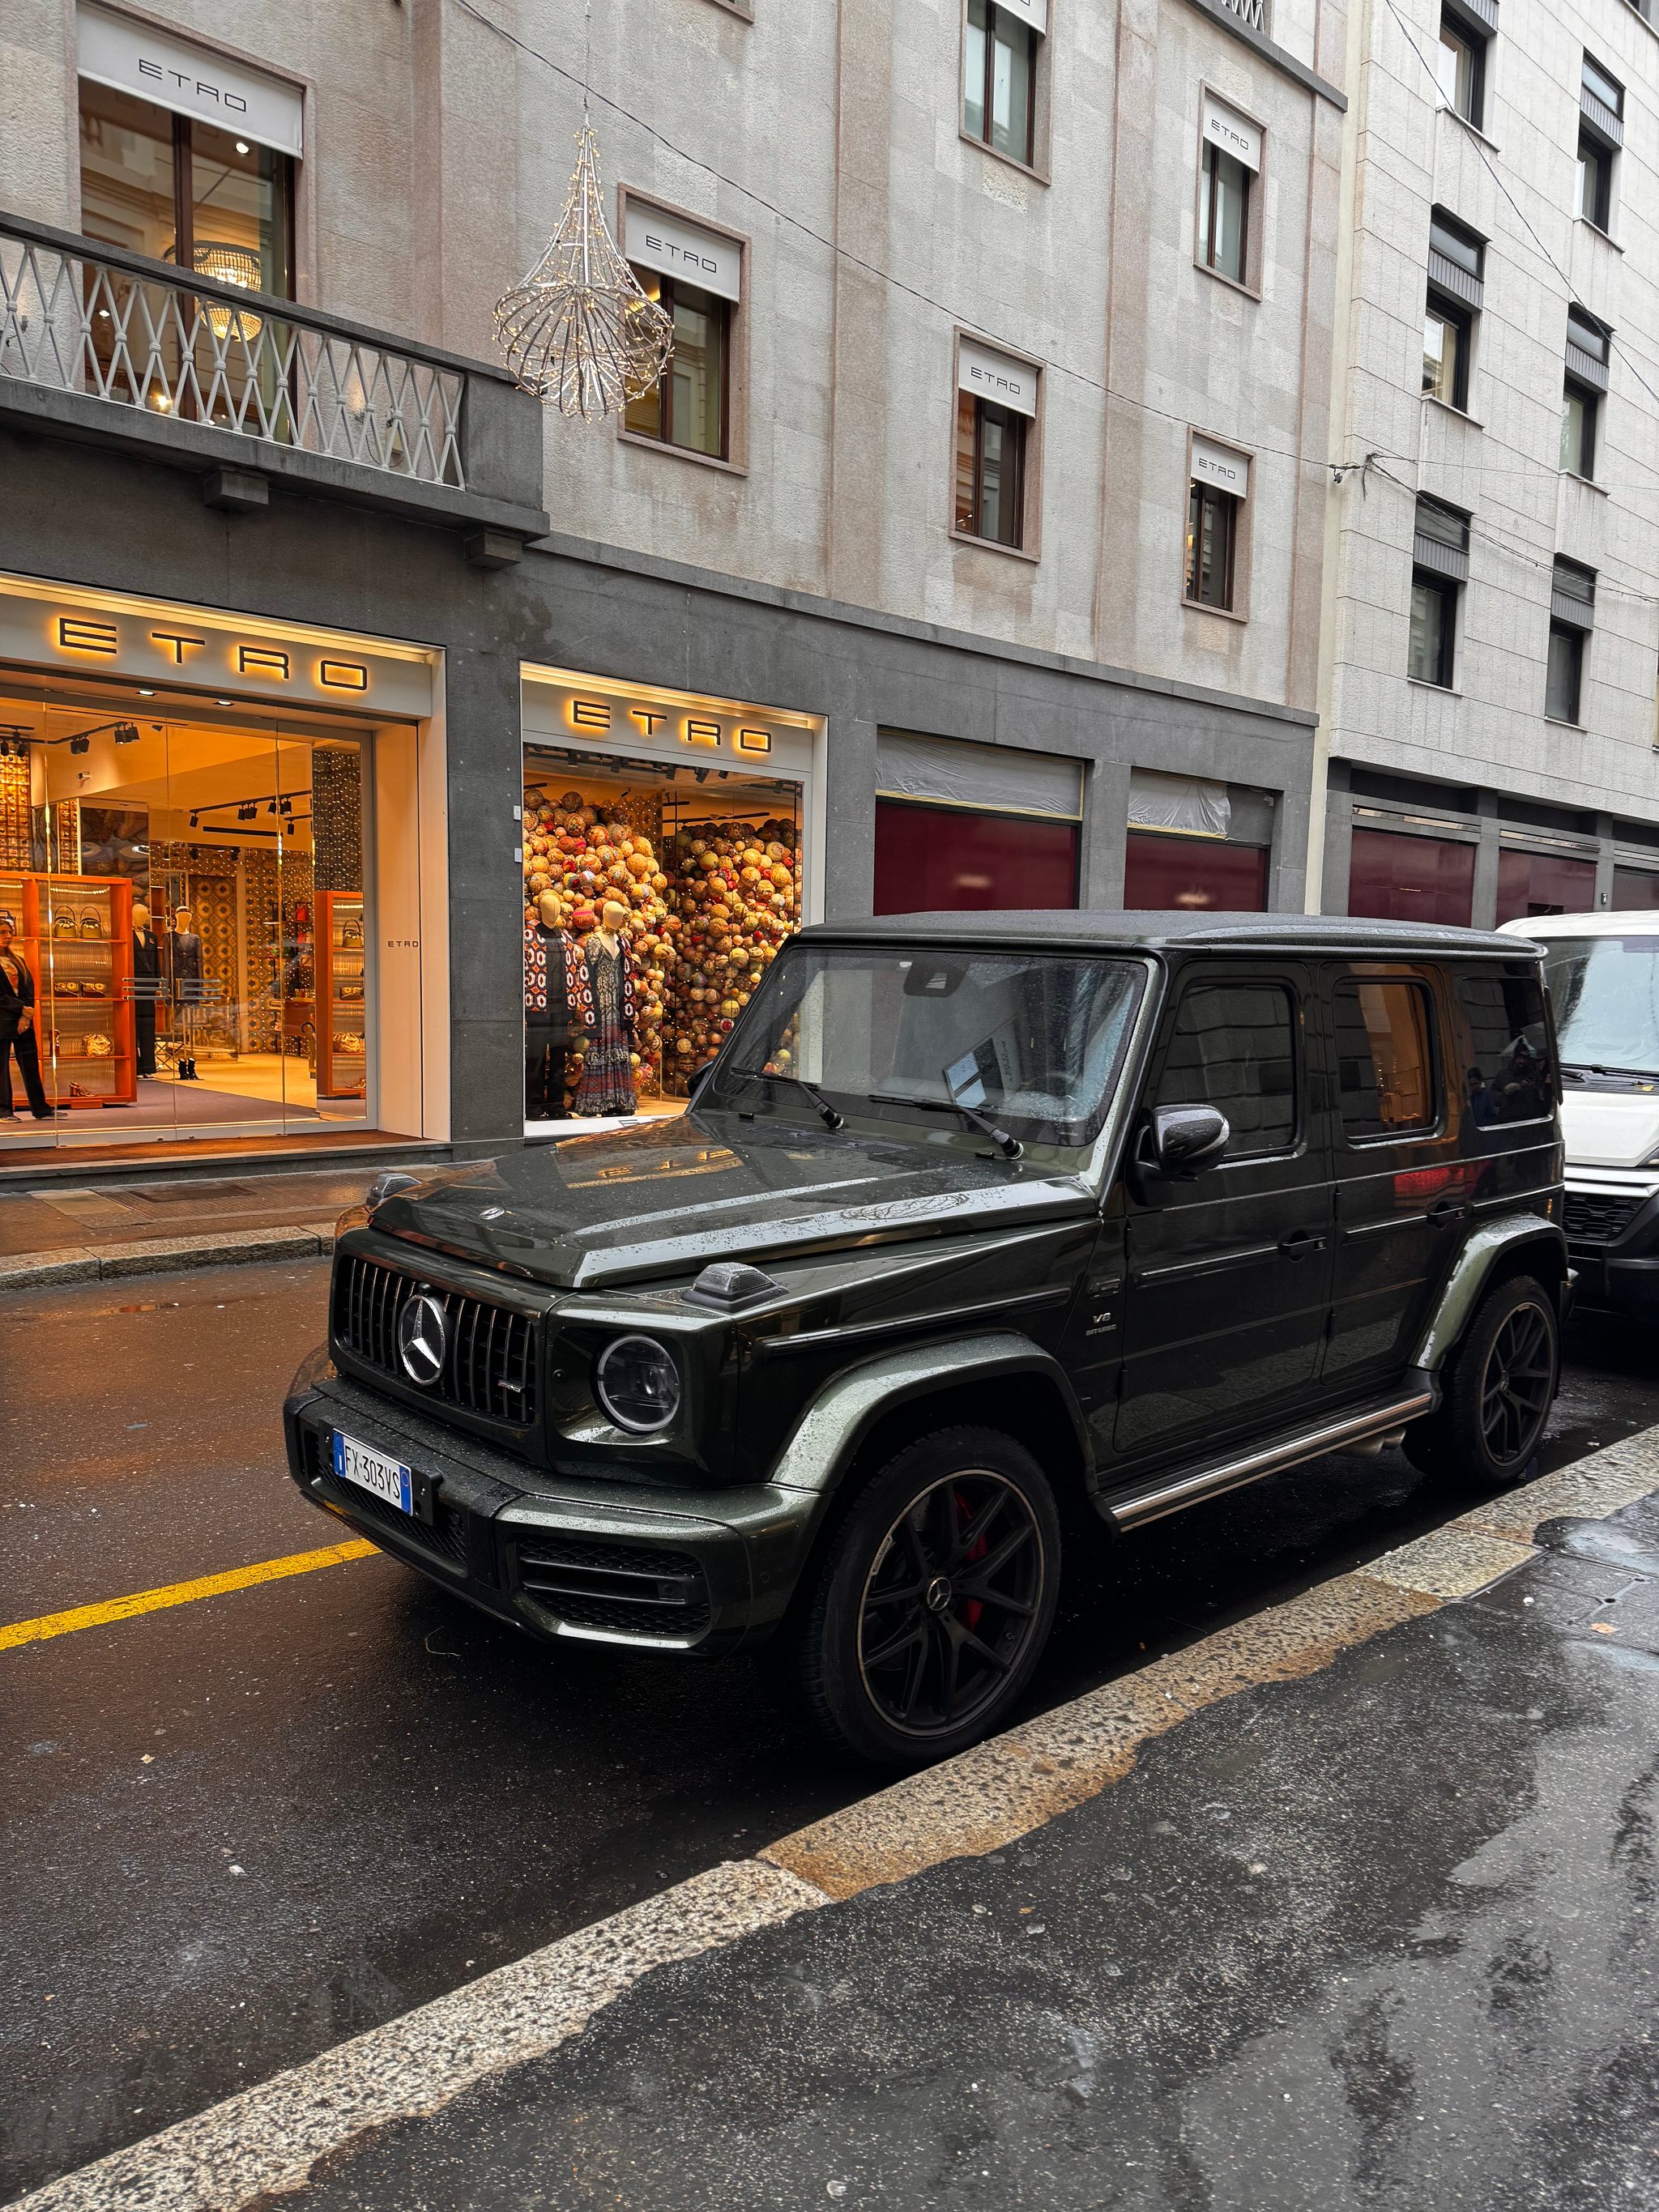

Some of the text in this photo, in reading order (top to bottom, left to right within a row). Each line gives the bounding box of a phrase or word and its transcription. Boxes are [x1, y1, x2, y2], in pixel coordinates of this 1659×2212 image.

[139, 58, 246, 113] ETRO
[1211, 118, 1248, 151] ETRO
[646, 235, 717, 274] ETRO
[971, 366, 1021, 395] ETRO
[1199, 458, 1236, 479] ETRO
[59, 617, 368, 691] ETRO
[573, 700, 772, 753] ETRO
